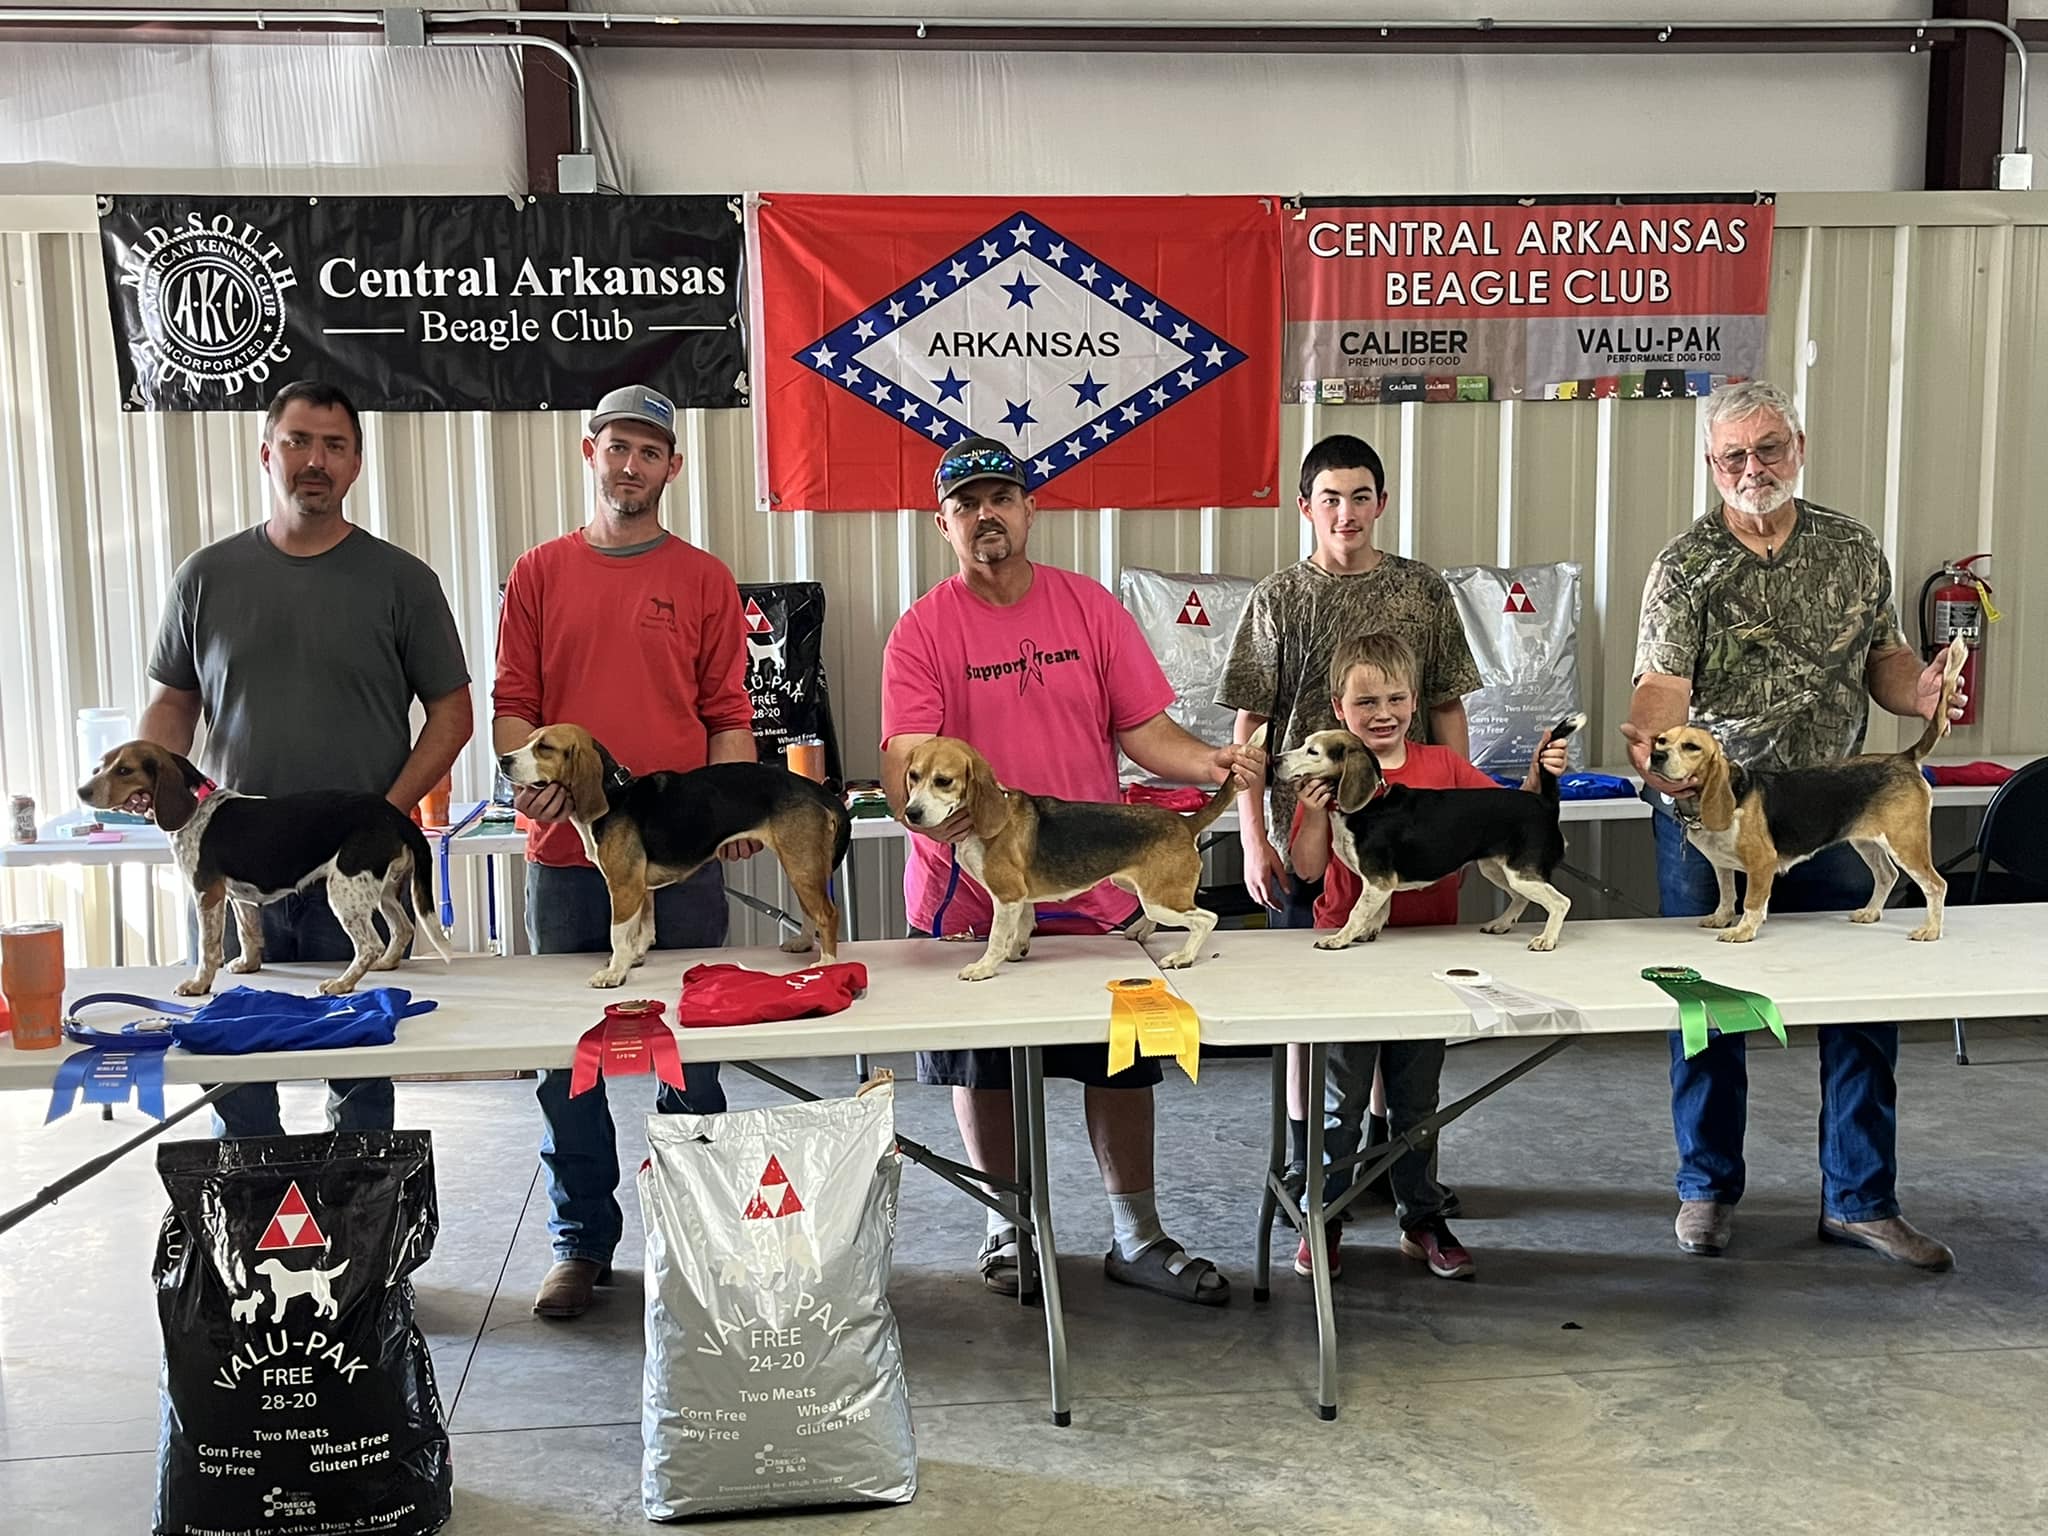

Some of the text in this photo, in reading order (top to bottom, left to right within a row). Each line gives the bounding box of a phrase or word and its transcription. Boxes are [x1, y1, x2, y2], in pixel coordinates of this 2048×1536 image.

[1307, 217, 1748, 259] CENTRAL ARKANSAS
[120, 211, 298, 289] MID-SOUTH
[196, 238, 257, 275] KENNEL
[254, 274, 277, 317] CLUB
[319, 256, 727, 298] Central Arkansas
[1385, 267, 1672, 307] BEAGLE CLUB
[420, 308, 634, 351] Beagle Club
[1577, 326, 1721, 354] VALU-PAK
[927, 332, 1121, 357] ARKANSAS
[1340, 330, 1468, 355] CALIBER
[161, 338, 265, 372] INCORPORATED
[1348, 355, 1461, 367] PREMIUM DOG FOOD
[1607, 353, 1721, 363] PERFORMANCE DOG FOOD
[225, 340, 291, 396] DOG
[966, 648, 1080, 681] Support Team
[751, 693, 778, 706] FREE
[765, 728, 788, 736] Meats
[751, 1327, 803, 1349] FREE
[213, 1329, 368, 1391] VALU-PAK
[749, 1351, 806, 1373] 24-20
[262, 1366, 314, 1387] FREE
[260, 1391, 317, 1410] 28-20
[739, 1387, 817, 1403] Two Meats
[680, 1406, 748, 1422] Corn Free
[797, 1398, 843, 1417] Wheat
[796, 1406, 871, 1437] Gluten Free
[253, 1428, 329, 1442] Two Meats
[310, 1432, 390, 1456] Wheat Free
[681, 1425, 740, 1442] Soy Free
[198, 1443, 262, 1459] Corn Free
[309, 1449, 391, 1474] Gluten Free
[199, 1461, 256, 1477] Soy Free
[369, 1502, 417, 1525] Puppies
